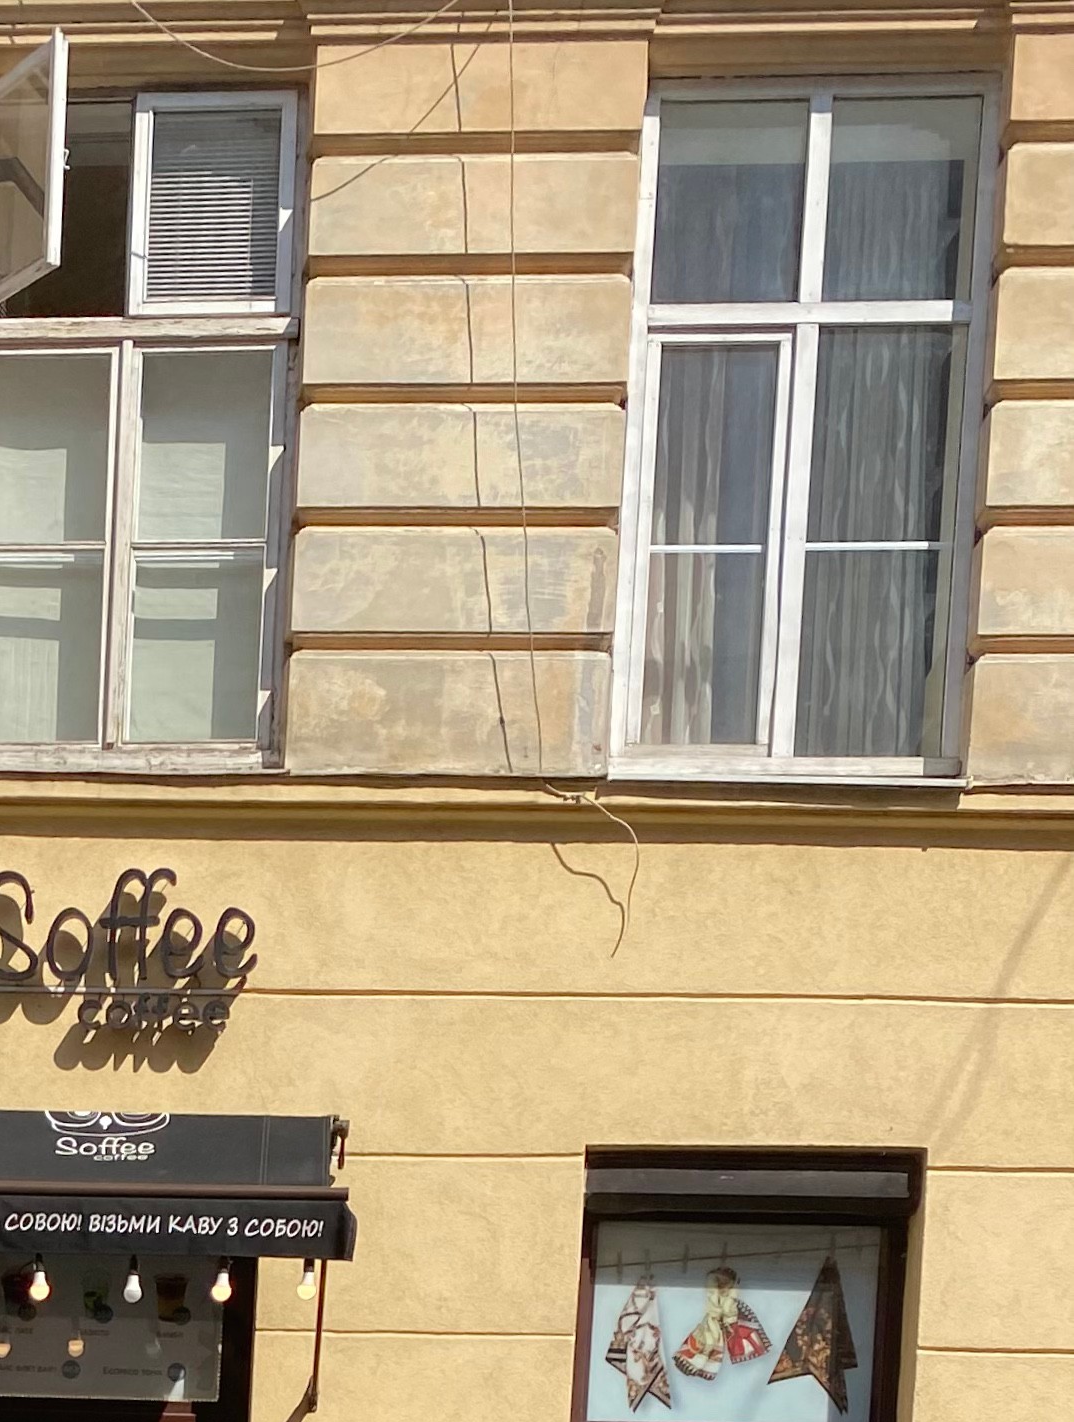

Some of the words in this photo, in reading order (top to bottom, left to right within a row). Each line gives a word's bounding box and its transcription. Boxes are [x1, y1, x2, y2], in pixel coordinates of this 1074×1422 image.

[78, 993, 230, 1036] coffee
[55, 1136, 155, 1155] Soffee
[4, 1212, 83, 1232] СОВОЮ!
[88, 1213, 161, 1234] ВІЗЬМИ
[168, 1214, 223, 1235] КАВУ
[244, 1218, 325, 1238] СОБОЮ!
